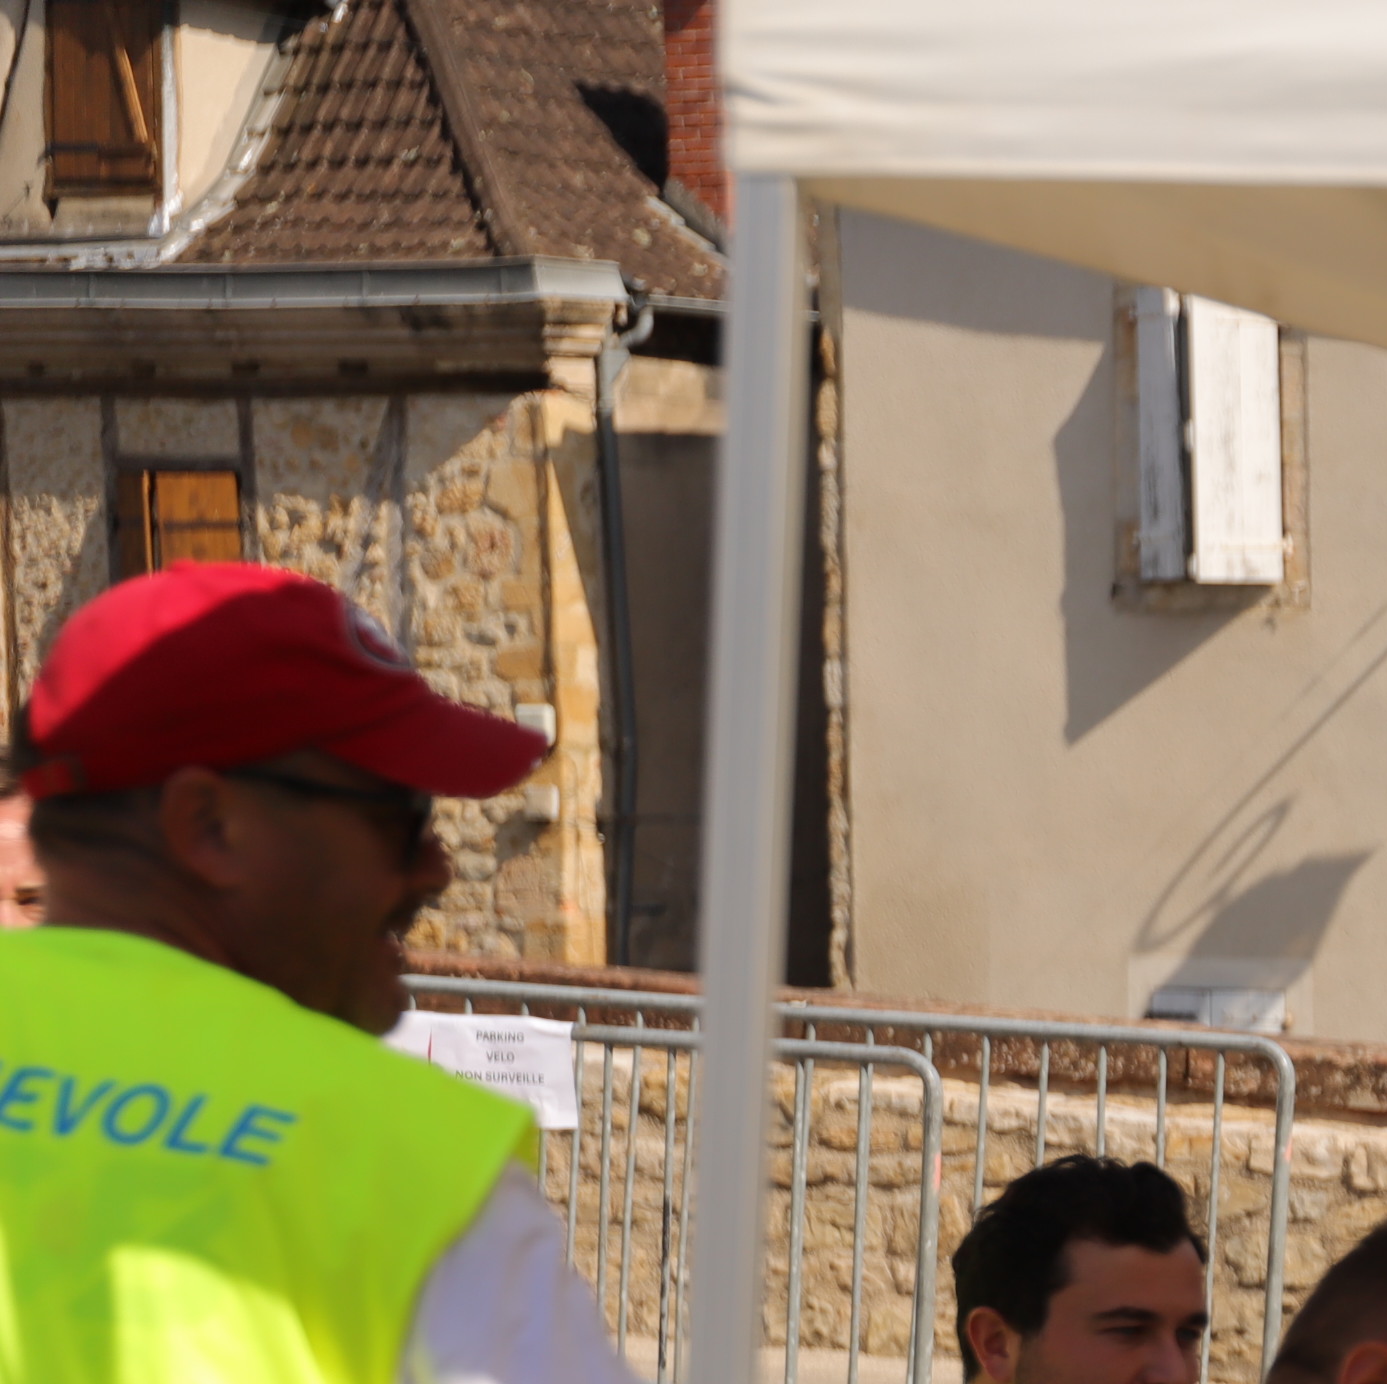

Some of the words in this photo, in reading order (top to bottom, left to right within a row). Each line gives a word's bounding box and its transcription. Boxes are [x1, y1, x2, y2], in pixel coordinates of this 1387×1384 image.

[475, 1029, 525, 1044] PARKING
[485, 1050, 516, 1064] VELO
[454, 1069, 483, 1083] NON
[484, 1070, 546, 1085] SURVEILLE
[0, 1064, 300, 1167] EVOLE
